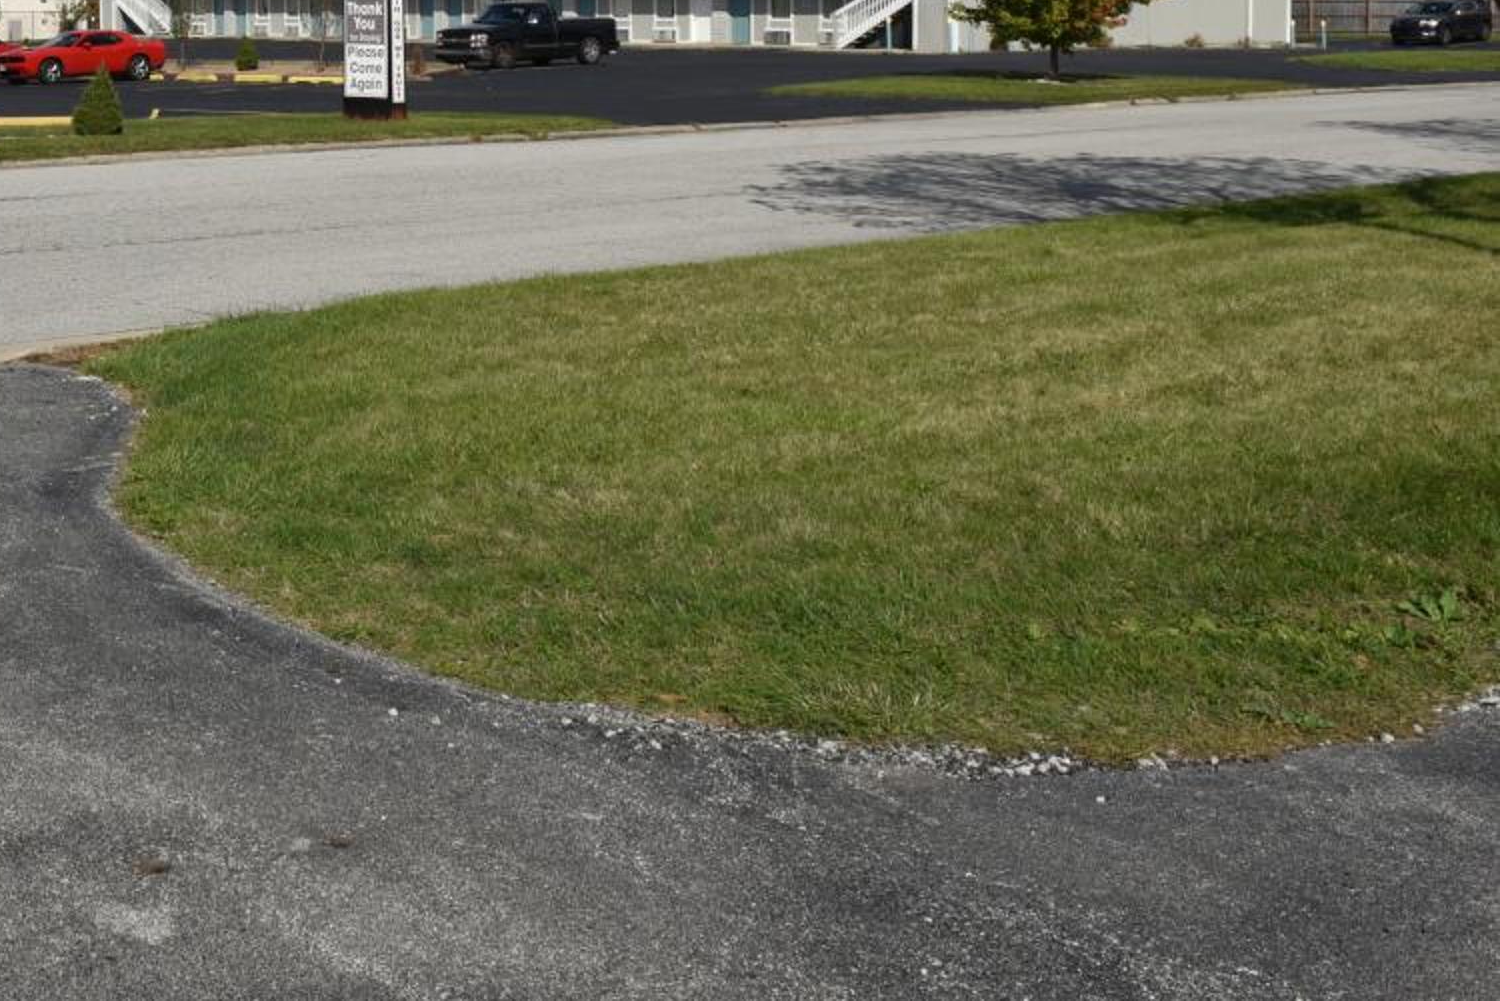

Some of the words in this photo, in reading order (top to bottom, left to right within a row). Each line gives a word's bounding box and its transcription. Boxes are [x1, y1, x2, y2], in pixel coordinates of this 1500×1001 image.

[346, 1, 383, 16] Thank
[354, 17, 376, 30] You
[347, 46, 384, 58] Please
[350, 62, 382, 74] Come
[350, 79, 383, 92] Again
